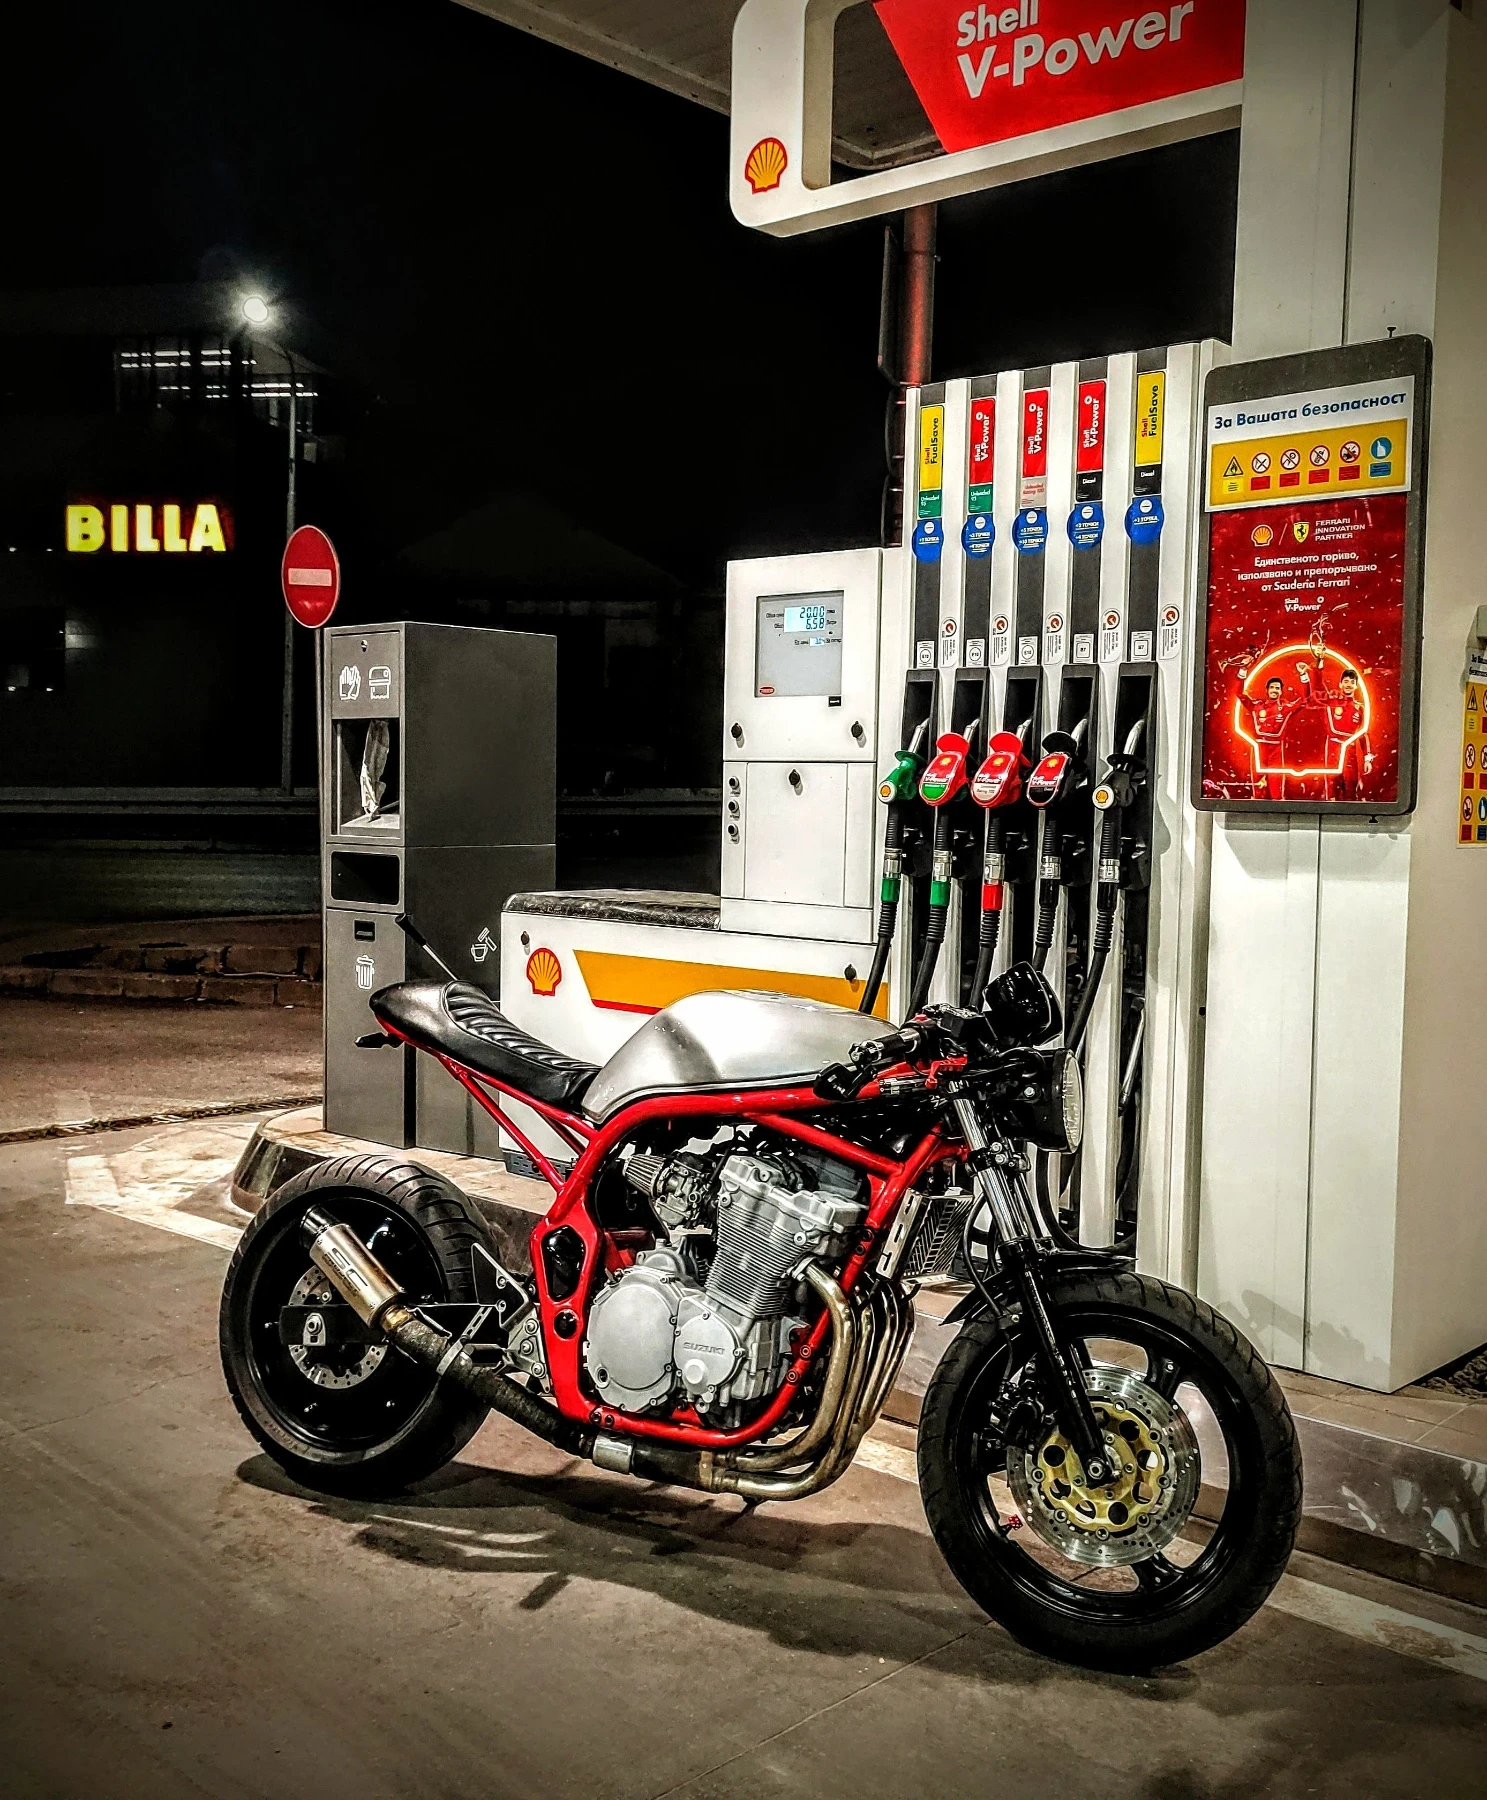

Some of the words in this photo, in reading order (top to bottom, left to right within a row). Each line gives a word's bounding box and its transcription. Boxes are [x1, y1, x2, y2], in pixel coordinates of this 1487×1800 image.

[956, 0, 1039, 47] Shell
[956, 1, 1194, 99] V-Power
[1148, 385, 1158, 436] FuelSave
[1214, 416, 1232, 430] За
[1236, 408, 1297, 426] Вашата
[1302, 392, 1406, 416] безопасност
[1034, 406, 1044, 454] V-Power
[1090, 398, 1099, 448] V-Power
[930, 418, 938, 464] FuelSave
[980, 414, 990, 461] V-Power
[1082, 429, 1090, 448] Shell
[66, 504, 227, 552] BILLA
[1315, 518, 1350, 526] FERRARI
[1315, 524, 1366, 534] INNOVATION
[1315, 532, 1353, 542] PARTNER
[1254, 556, 1319, 568] Единственото
[1321, 552, 1359, 564] гориво,
[1304, 564, 1377, 578] препоръчвано
[1261, 584, 1273, 592] от
[1274, 579, 1316, 591] Scuderia
[1318, 576, 1350, 588] Ferrari
[800, 606, 824, 618] 20.00
[1284, 604, 1321, 612] V-Power
[683, 1342, 726, 1356] SUZUKI
